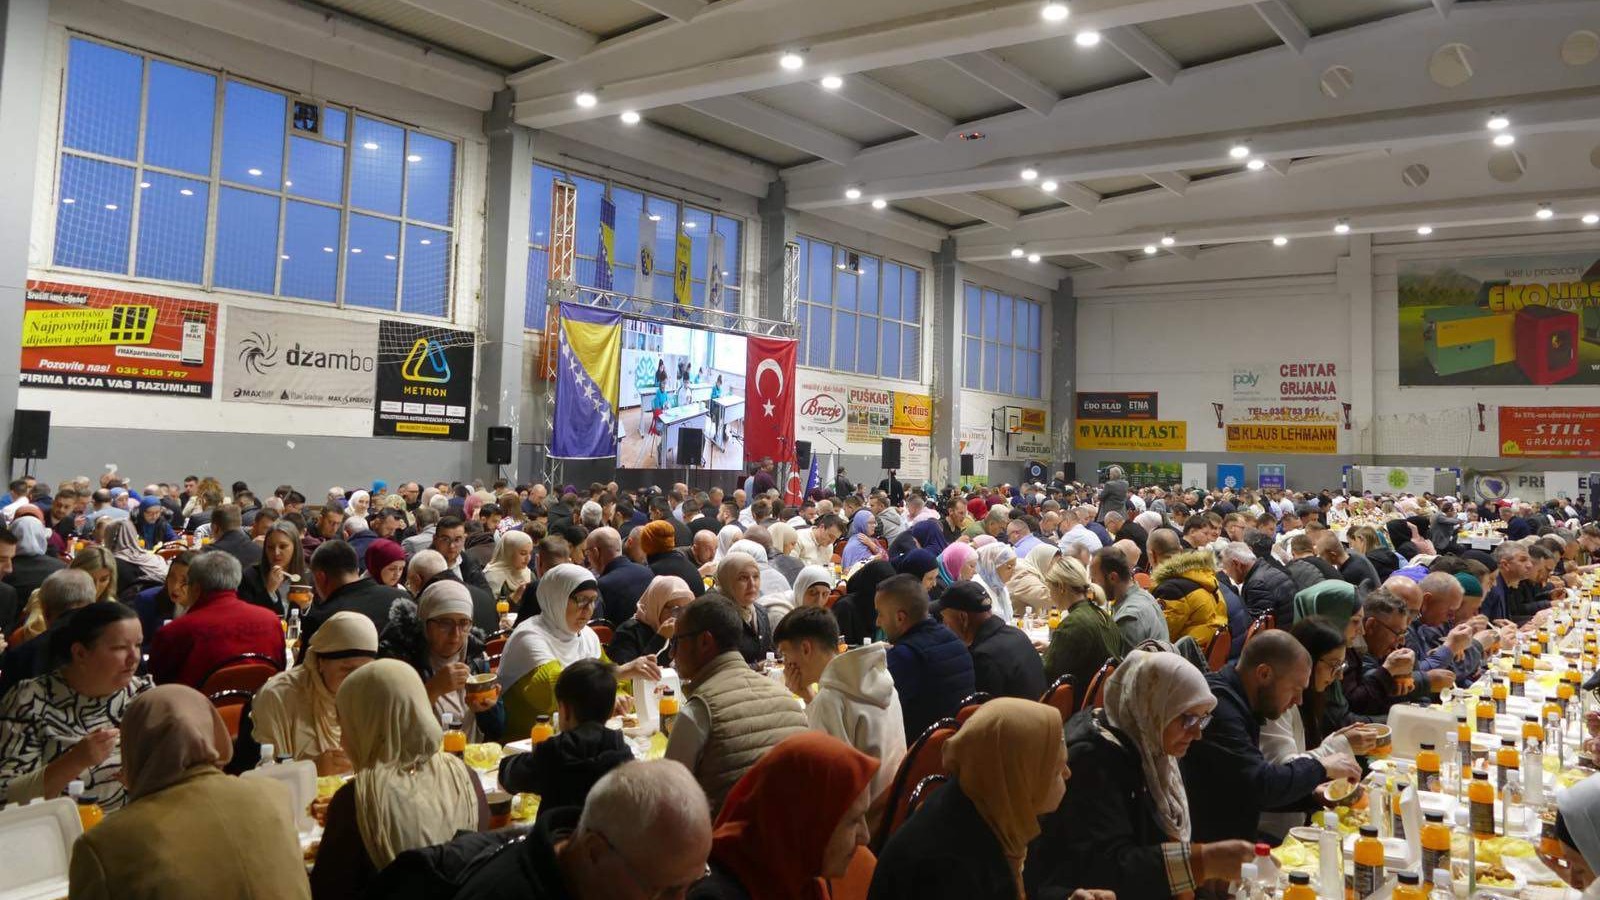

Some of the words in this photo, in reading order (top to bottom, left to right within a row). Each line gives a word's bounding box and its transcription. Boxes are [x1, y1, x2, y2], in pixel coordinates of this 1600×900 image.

[42, 310, 104, 318] GARANTOVANO
[31, 319, 109, 334] Najpovoljniji
[26, 334, 63, 346] dijelovi
[74, 333, 103, 345] gradu
[286, 342, 374, 373] dzambo
[39, 359, 85, 371] Pozovite
[86, 364, 111, 373] nas!
[116, 366, 139, 375] 035
[1279, 363, 1337, 377] CENTAR
[19, 373, 64, 385] FIRMA
[67, 376, 104, 387] KOJA
[106, 379, 133, 389] VAS
[136, 381, 202, 393] RAZUMIJE!
[1232, 371, 1259, 389] poly
[403, 385, 447, 397] METRON
[1279, 381, 1337, 395] GRIJANJA
[850, 388, 889, 405] PUŠKAR
[801, 397, 842, 420] Brezje
[903, 405, 929, 417] radius
[1101, 402, 1122, 410] SLAD
[1128, 400, 1149, 410] ETNA
[1092, 424, 1178, 439] VARIPLAST
[1242, 426, 1278, 440] KLAUS
[1280, 427, 1336, 441] LEHMANN
[1535, 423, 1582, 435] STIL
[1526, 437, 1592, 446] GRAČANICA
